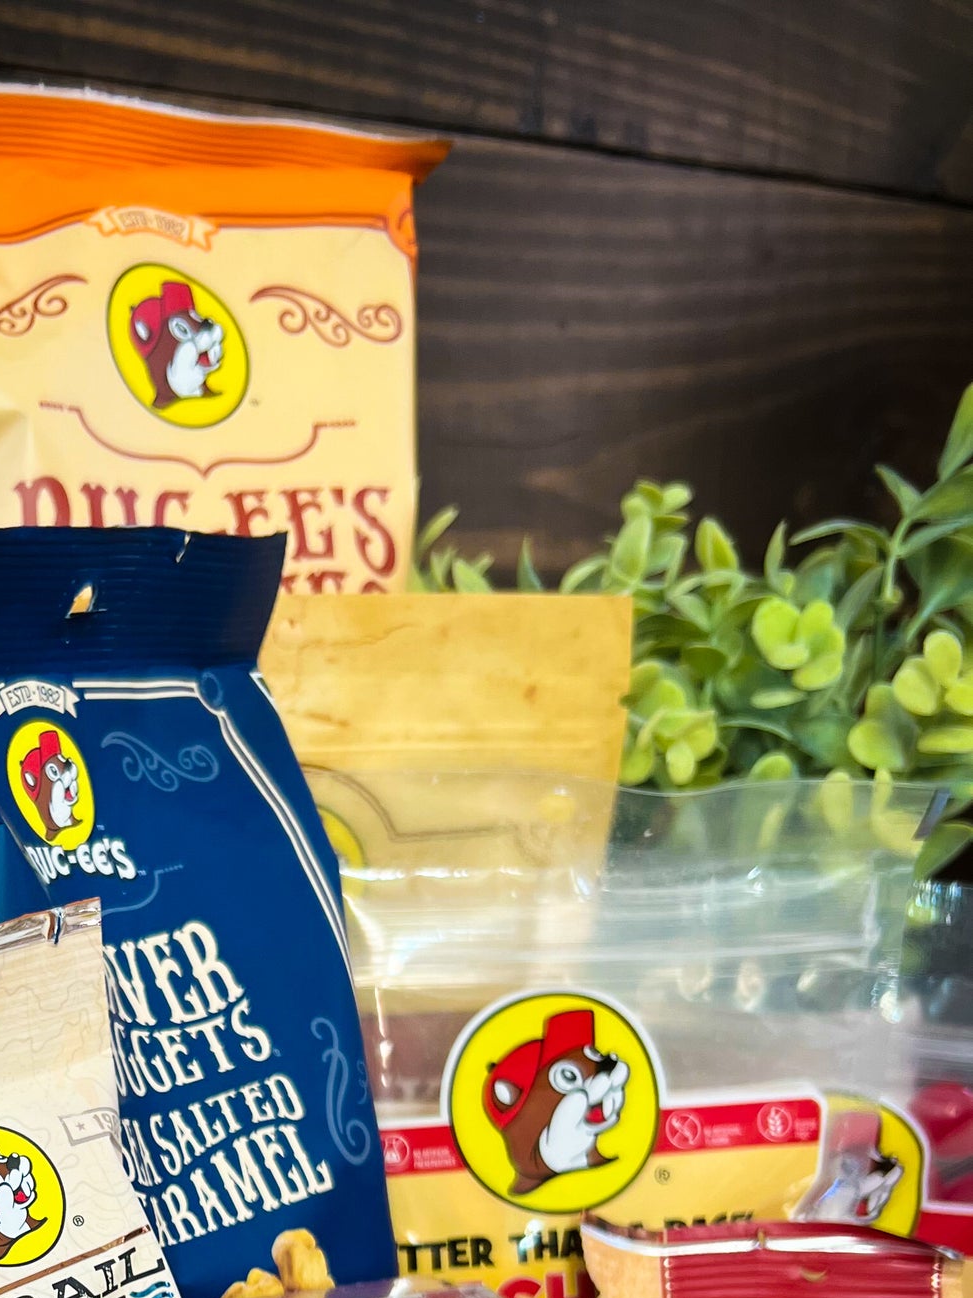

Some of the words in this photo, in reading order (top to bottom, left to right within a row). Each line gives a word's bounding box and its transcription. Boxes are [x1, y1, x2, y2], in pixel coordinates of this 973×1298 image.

[148, 1073, 307, 1177] SALTED
[135, 1123, 335, 1248] ARAMEL
[398, 1236, 495, 1273] TTER
[508, 1228, 582, 1264] THA
